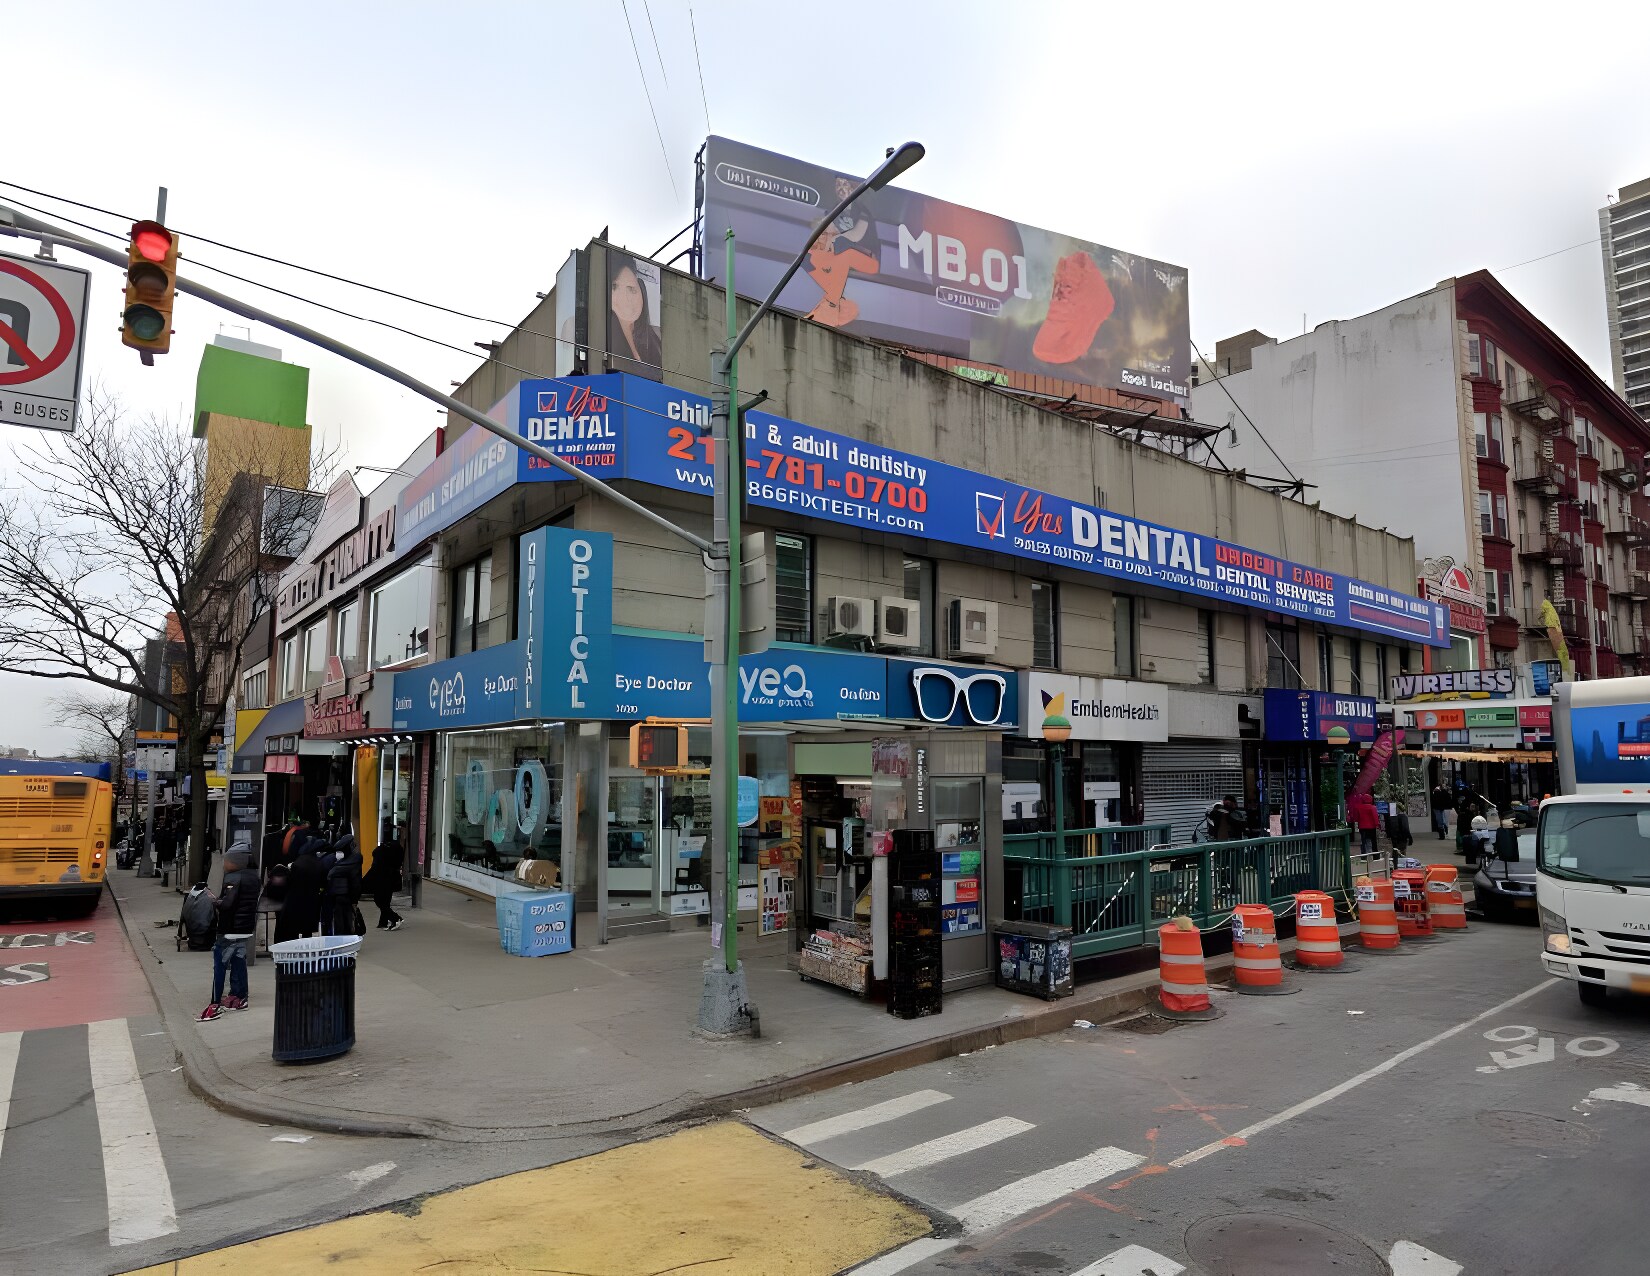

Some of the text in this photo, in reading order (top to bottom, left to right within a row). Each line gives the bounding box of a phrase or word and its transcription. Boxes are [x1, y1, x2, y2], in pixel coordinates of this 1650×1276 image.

[898, 224, 1032, 299] MB.01
[14, 401, 69, 422] BUSES
[528, 414, 616, 441] DENTAL
[667, 400, 927, 487] chiln & adult dentistry
[1013, 490, 1063, 535] Yes
[1071, 505, 1210, 577] DENTAL
[1216, 564, 1271, 592] DENTAL
[1275, 580, 1335, 607] SERVICES
[567, 539, 593, 709] OPTICAL
[615, 673, 693, 692] Eye Doctor
[1392, 669, 1513, 697] WIRELESS
